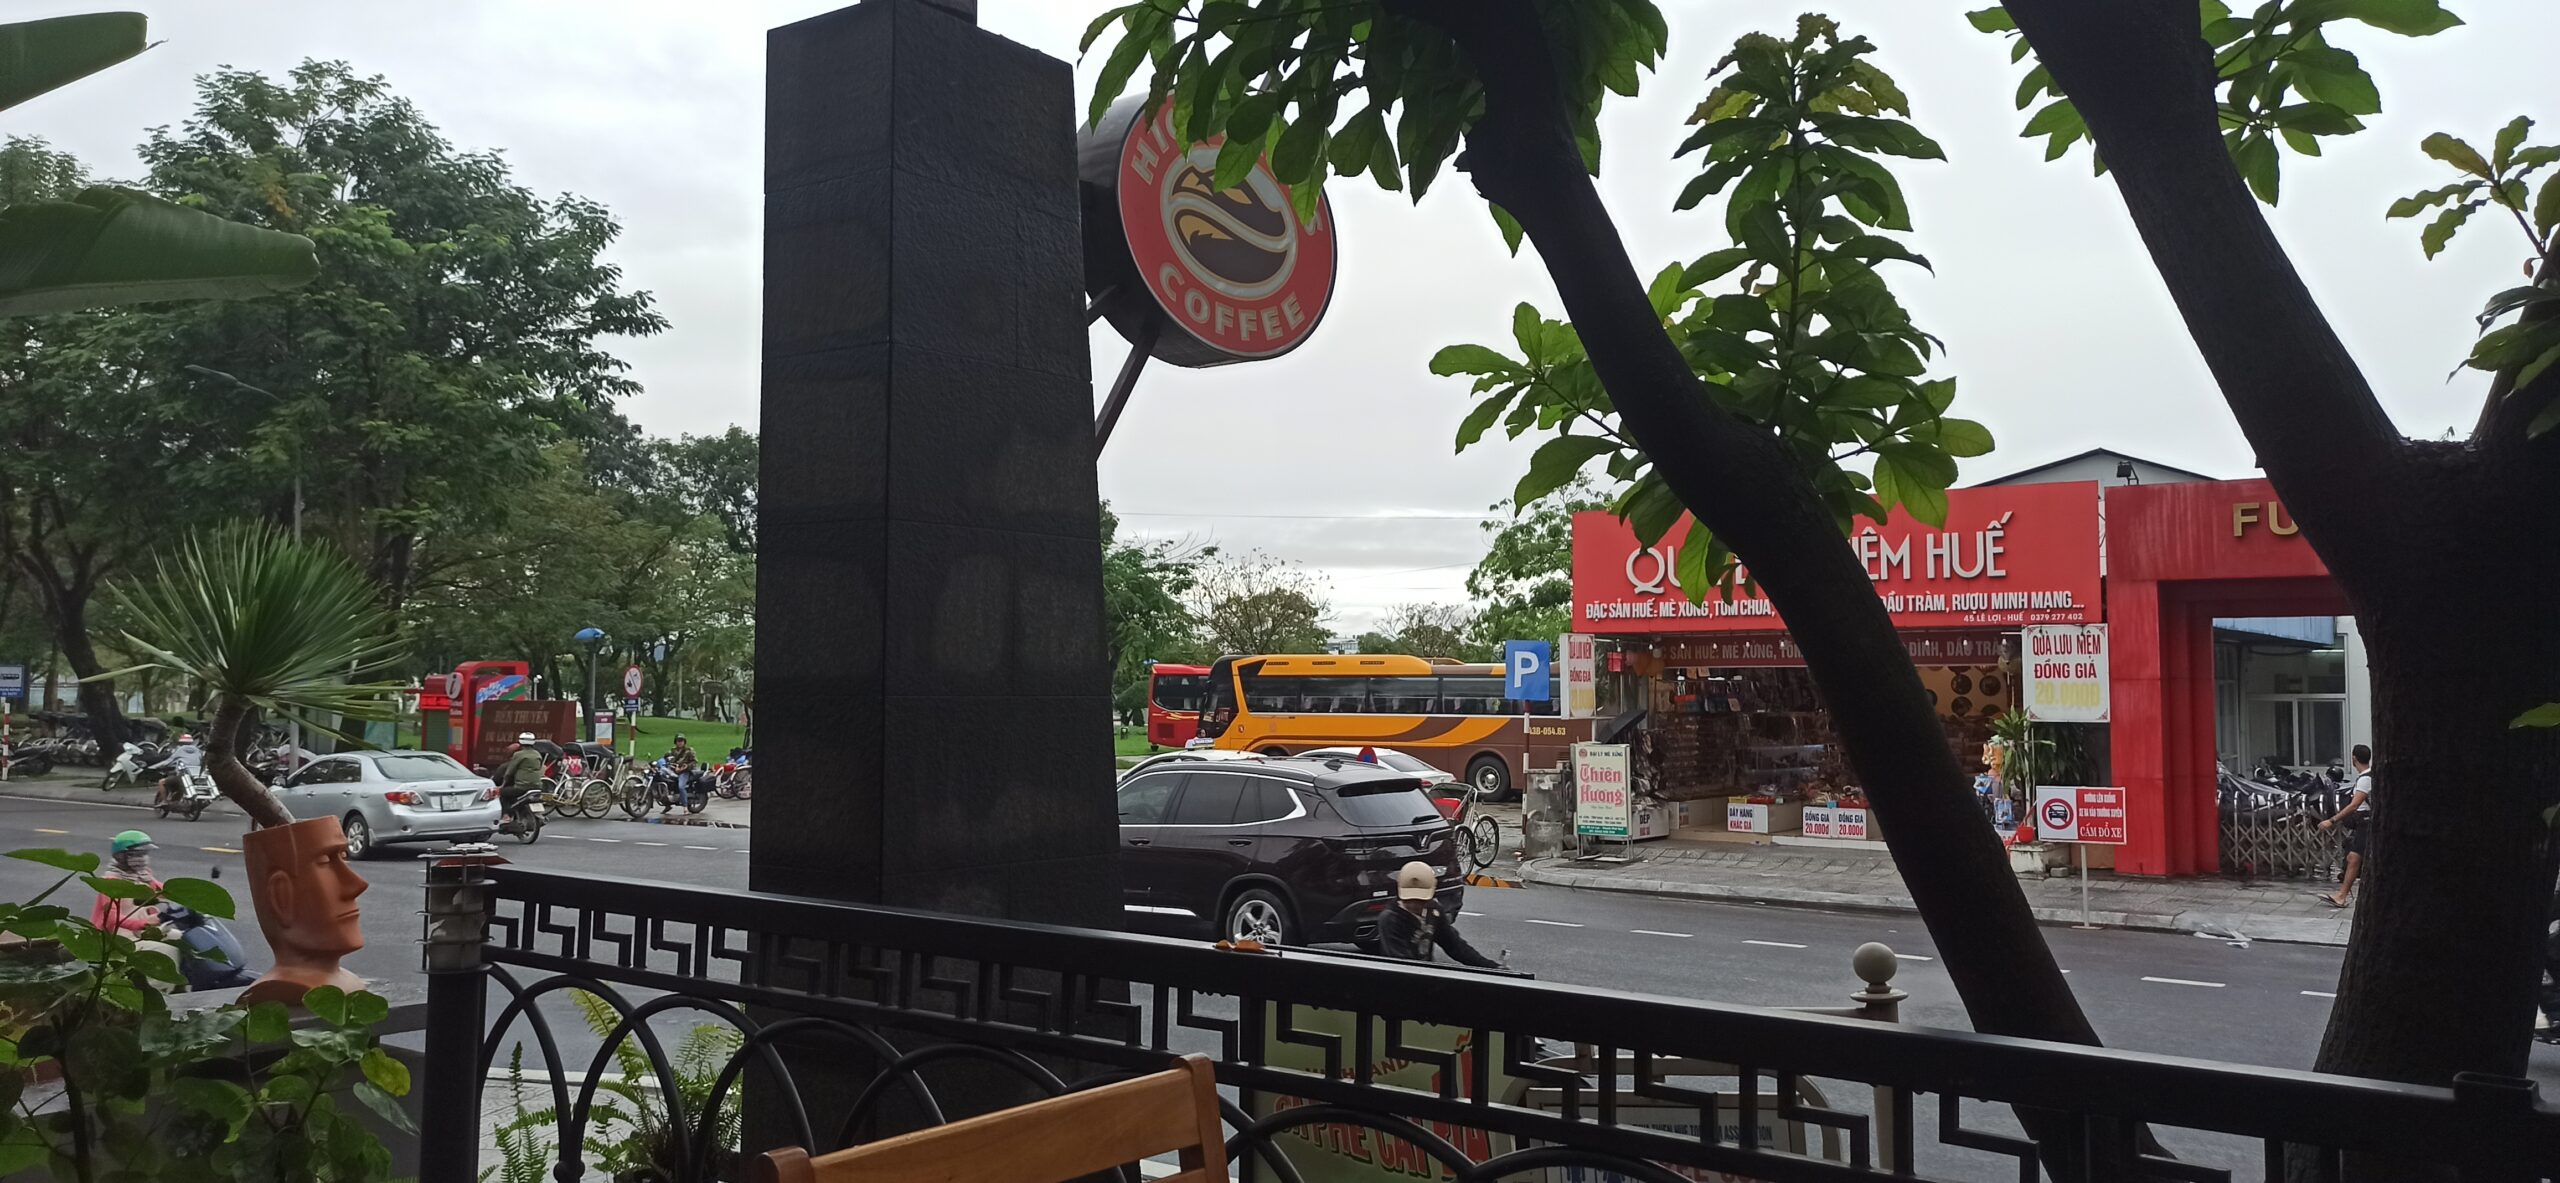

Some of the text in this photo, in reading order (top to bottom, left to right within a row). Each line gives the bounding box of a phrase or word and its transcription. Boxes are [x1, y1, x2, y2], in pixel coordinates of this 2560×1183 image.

[1159, 262, 1304, 341] COFFEE
[1926, 511, 2013, 579] HUẾ
[1586, 600, 1608, 622] ĐẶC
[1609, 598, 1631, 618] SẢN
[1632, 597, 1658, 618] HUẾ:
[1660, 598, 1677, 617] MÈ
[1906, 590, 1949, 613] TRÀM,
[1952, 592, 1988, 614] RƯỢU
[1991, 591, 2028, 610] MINH
[1963, 614, 1975, 622] 45
[2007, 611, 2024, 622] HUẾ
[2030, 613, 2050, 622] 0379
[2051, 613, 2065, 621] 277
[2067, 613, 2083, 621] 402
[2033, 629, 2101, 659] QUÀ LƯU NIỆM
[1514, 651, 1539, 688] P
[2075, 659, 2097, 679] GIÁ
[2111, 827, 2123, 838] XE
